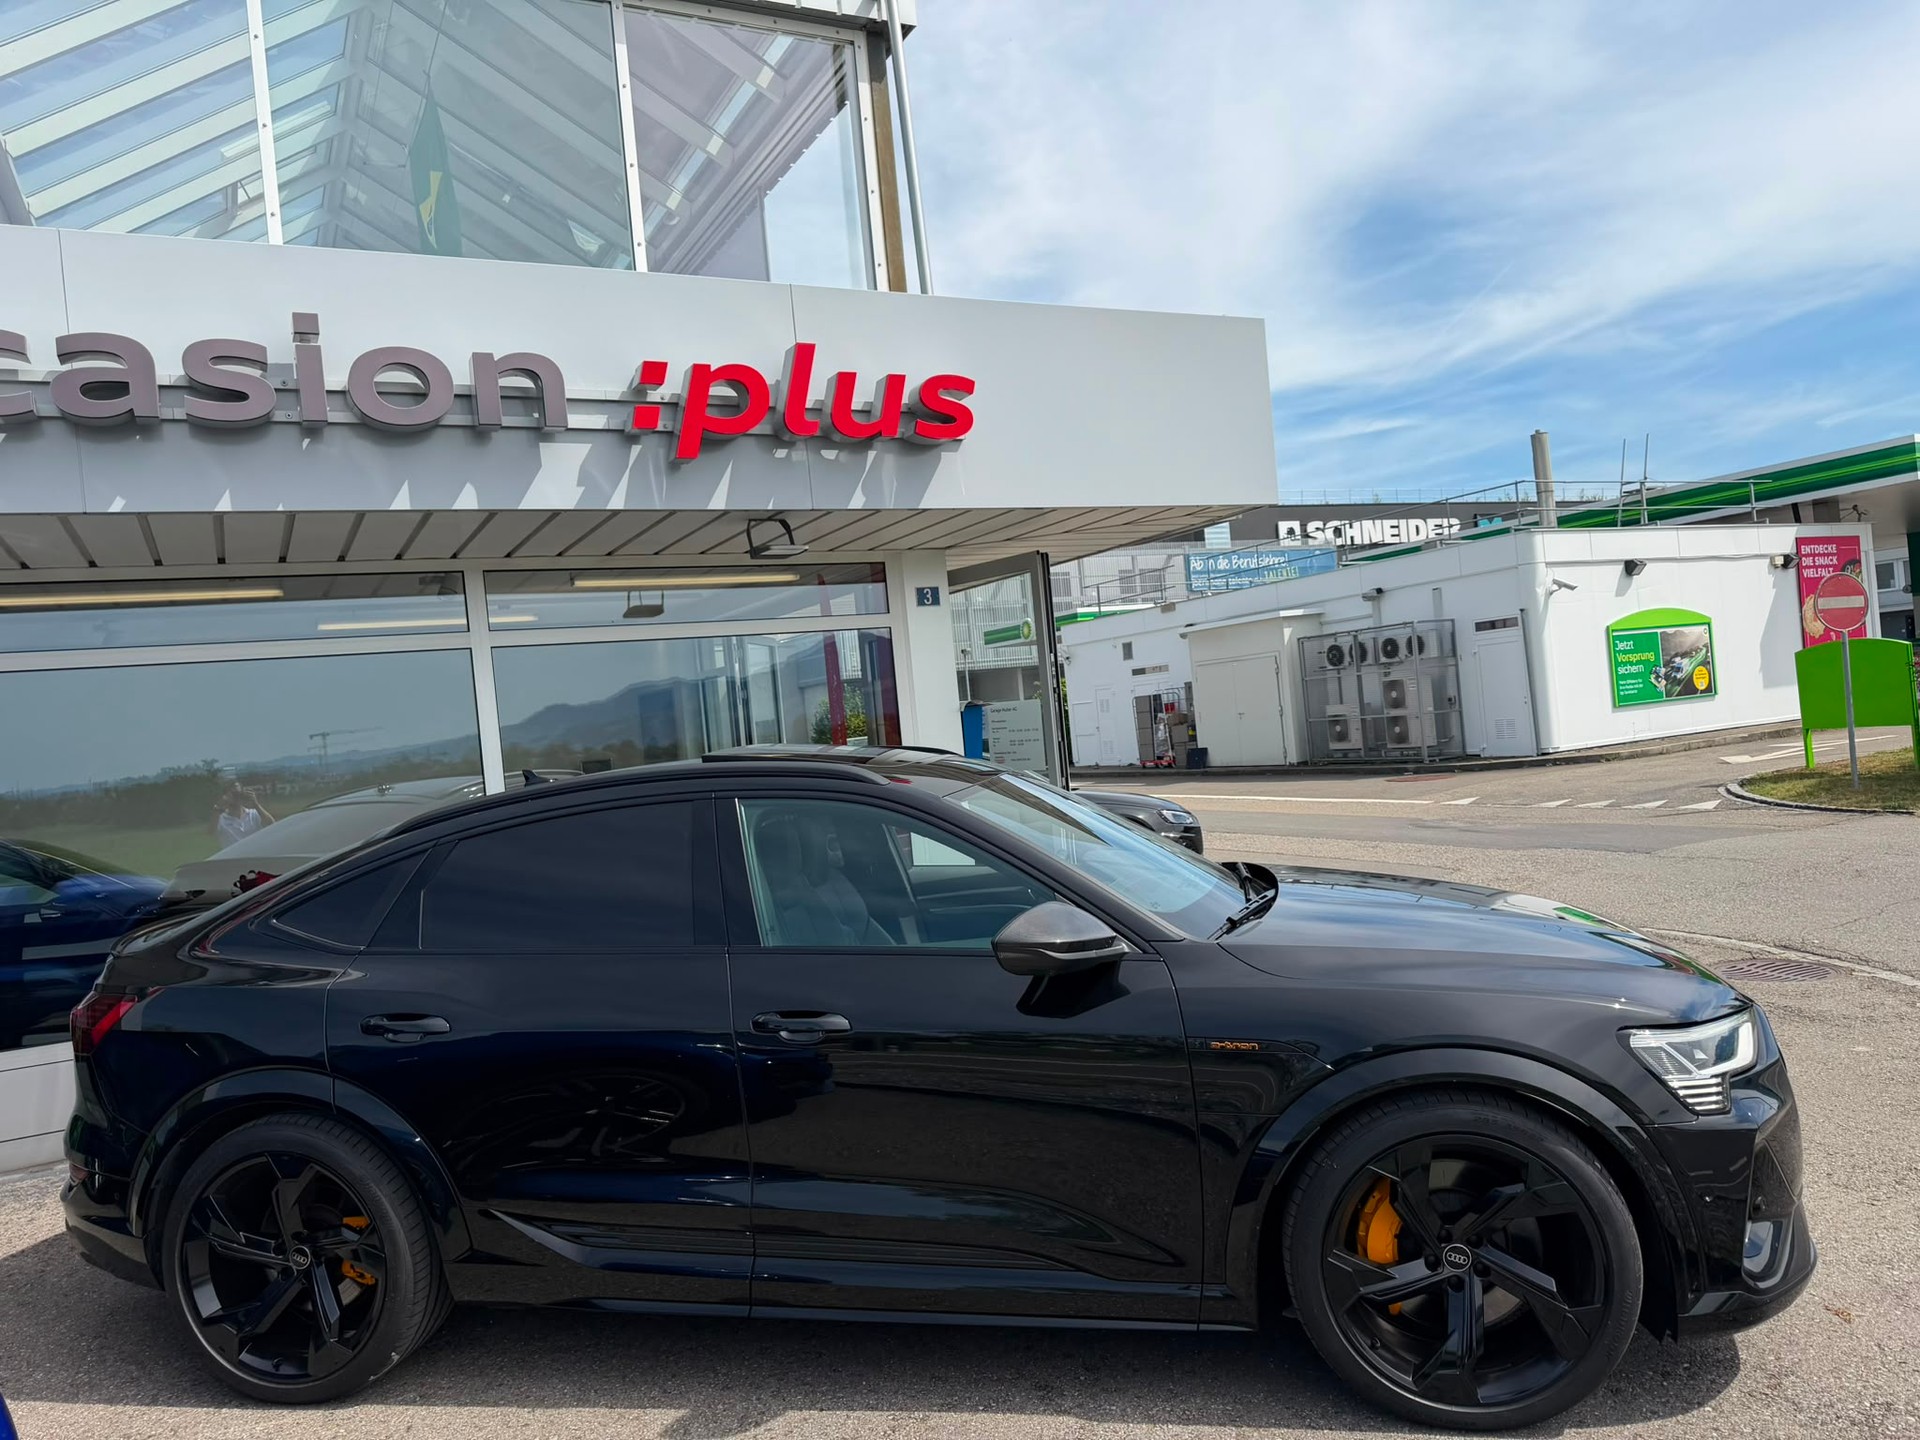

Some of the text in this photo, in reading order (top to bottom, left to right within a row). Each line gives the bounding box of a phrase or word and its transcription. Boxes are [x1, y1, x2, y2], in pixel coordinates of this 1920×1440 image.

[630, 341, 976, 463] :plus
[1306, 517, 1461, 546] SCHNEIDER
[1800, 544, 1837, 555] ENTDECKE
[1217, 556, 1230, 571] die
[1801, 556, 1838, 567] DIE SNACK
[1802, 567, 1834, 578] VIELFALT
[923, 588, 933, 605] 3
[1614, 640, 1634, 651] Jetzt
[1616, 652, 1655, 663] Vorsprung
[1617, 664, 1645, 675] sichern
